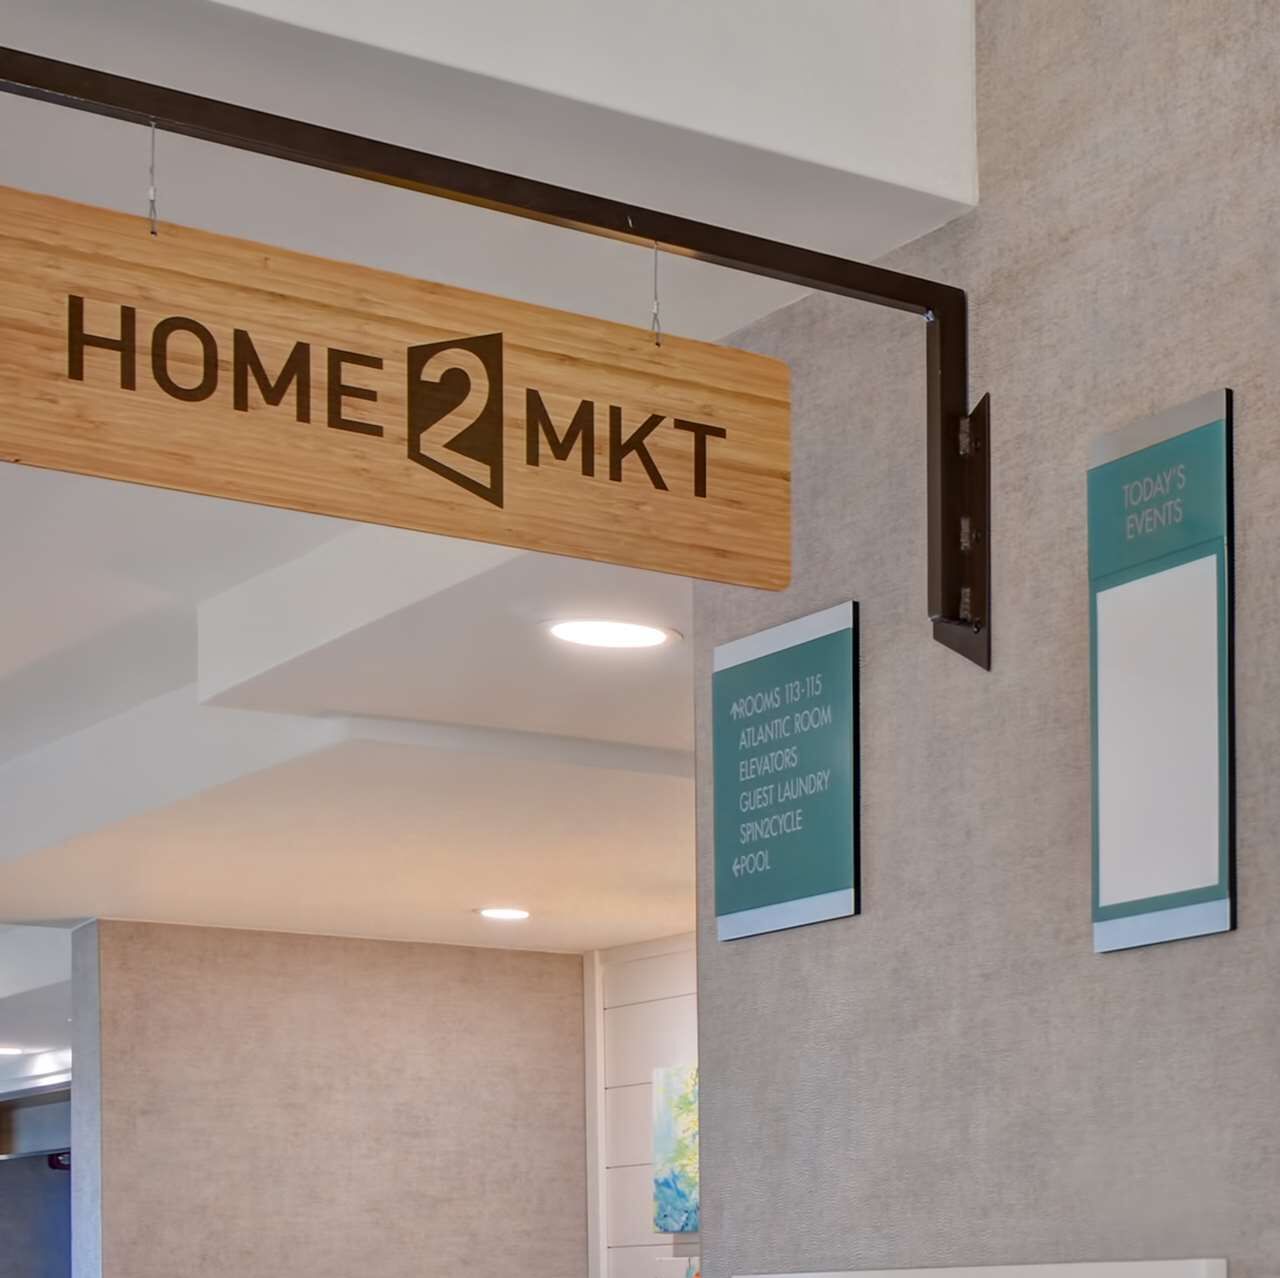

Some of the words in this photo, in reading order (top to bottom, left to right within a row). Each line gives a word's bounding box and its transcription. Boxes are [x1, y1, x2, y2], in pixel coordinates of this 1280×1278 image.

[1122, 464, 1185, 510] TODAY'S
[1126, 499, 1183, 540] EVENTS
[738, 688, 780, 718] ROOMS
[785, 674, 823, 704] 113-115
[739, 715, 790, 750] ATLANTIC
[794, 705, 832, 735] ROOM
[739, 746, 798, 781] ELEVATORS
[739, 785, 774, 812] GUEST
[777, 769, 831, 802] LAUNDRY
[739, 809, 803, 844] SPIN2CYCLE
[740, 850, 771, 877] POOL
